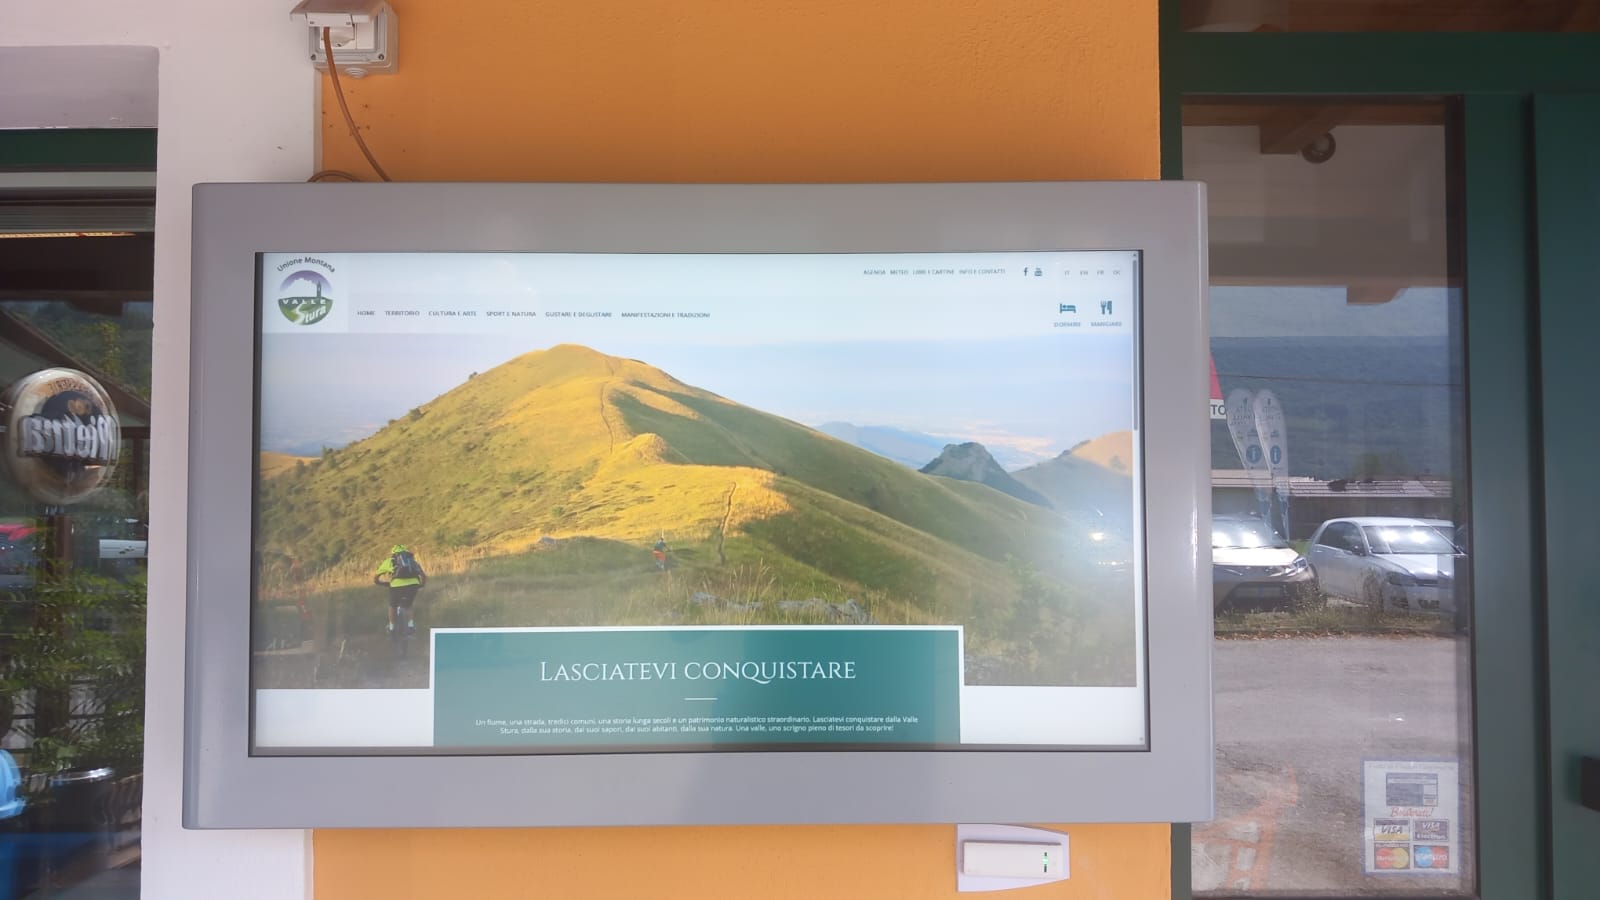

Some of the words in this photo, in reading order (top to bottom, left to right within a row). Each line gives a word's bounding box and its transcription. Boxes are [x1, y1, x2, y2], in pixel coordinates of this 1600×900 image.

[277, 258, 303, 272] Unione
[304, 256, 336, 273] Montana
[633, 717, 651, 726] lunga
[688, 717, 724, 725] patrimonio
[845, 716, 884, 724] conquistare
[783, 725, 807, 733] scrigno
[808, 725, 827, 733] pieno
[865, 724, 894, 732] scoprire!
[1381, 825, 1403, 834] VISA
[1422, 821, 1440, 829] VISA
